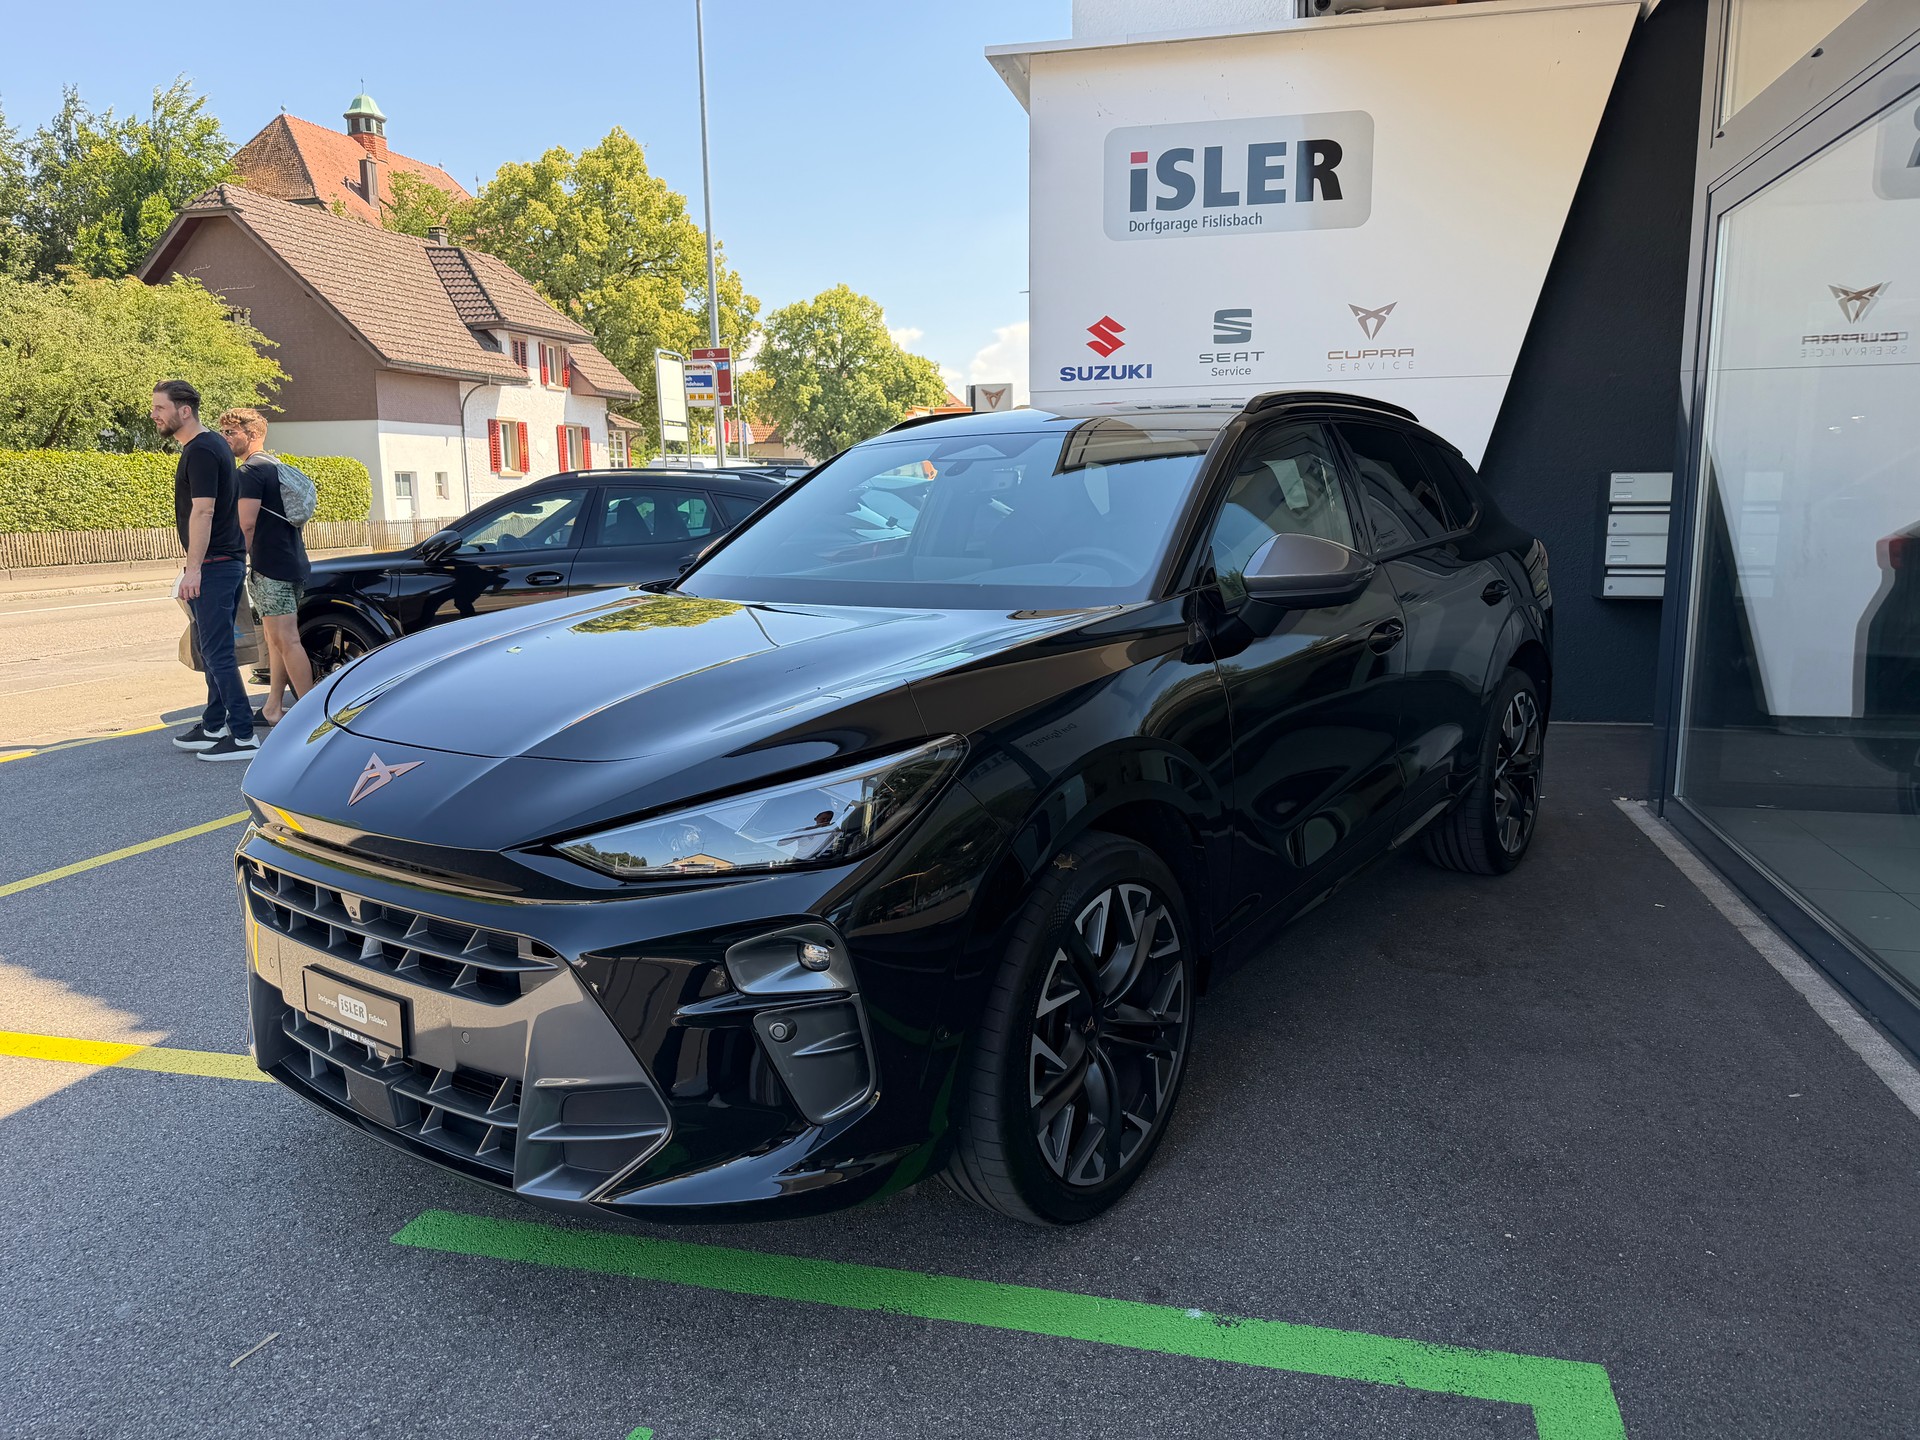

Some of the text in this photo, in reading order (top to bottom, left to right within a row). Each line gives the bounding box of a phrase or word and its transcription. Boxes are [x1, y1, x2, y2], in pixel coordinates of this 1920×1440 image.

[1130, 139, 1343, 213] iSLER
[1129, 212, 1263, 235] Dorfgarage Fislisbach
[1200, 351, 1265, 364] SEAT
[1327, 348, 1415, 360] CUPRA
[1060, 364, 1152, 382] SUZUKI
[1211, 366, 1252, 377] Service
[1327, 361, 1415, 372] SERVICE
